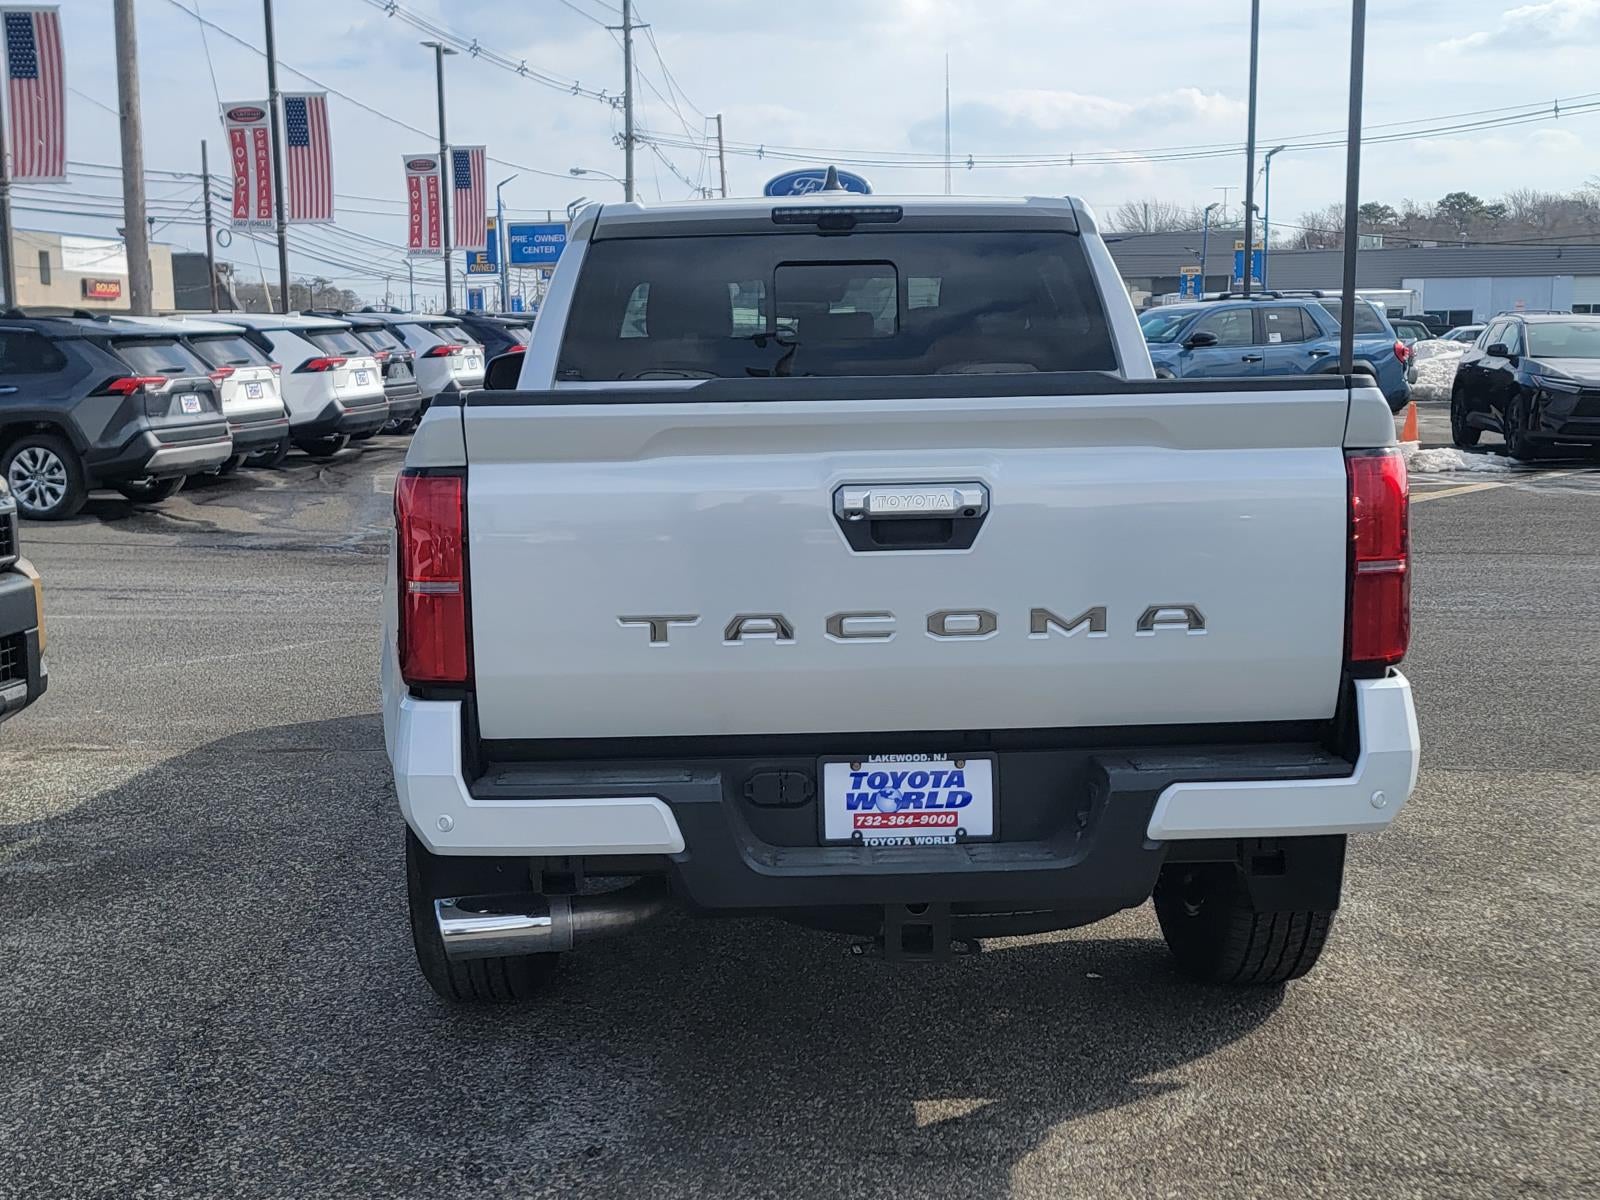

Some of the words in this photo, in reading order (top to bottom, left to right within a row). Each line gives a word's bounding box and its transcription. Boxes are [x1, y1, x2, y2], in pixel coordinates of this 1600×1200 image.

[234, 131, 248, 217] TOYOTA
[255, 129, 270, 217] CERTIFIED
[411, 178, 421, 246] TOYOTA
[429, 177, 438, 246] CERTIFIED
[534, 234, 565, 243] OWNED
[522, 246, 556, 254] CENTER
[469, 263, 496, 272] OWNED
[874, 494, 950, 509] TOYOTA
[615, 604, 1209, 648] TACOMA
[933, 753, 948, 762] NJ
[849, 770, 966, 790] TOYOTA
[846, 790, 973, 812] WORLD
[855, 814, 956, 827] 732-364-9000
[862, 837, 911, 847] TOYOTA
[914, 835, 957, 846] WORLD
